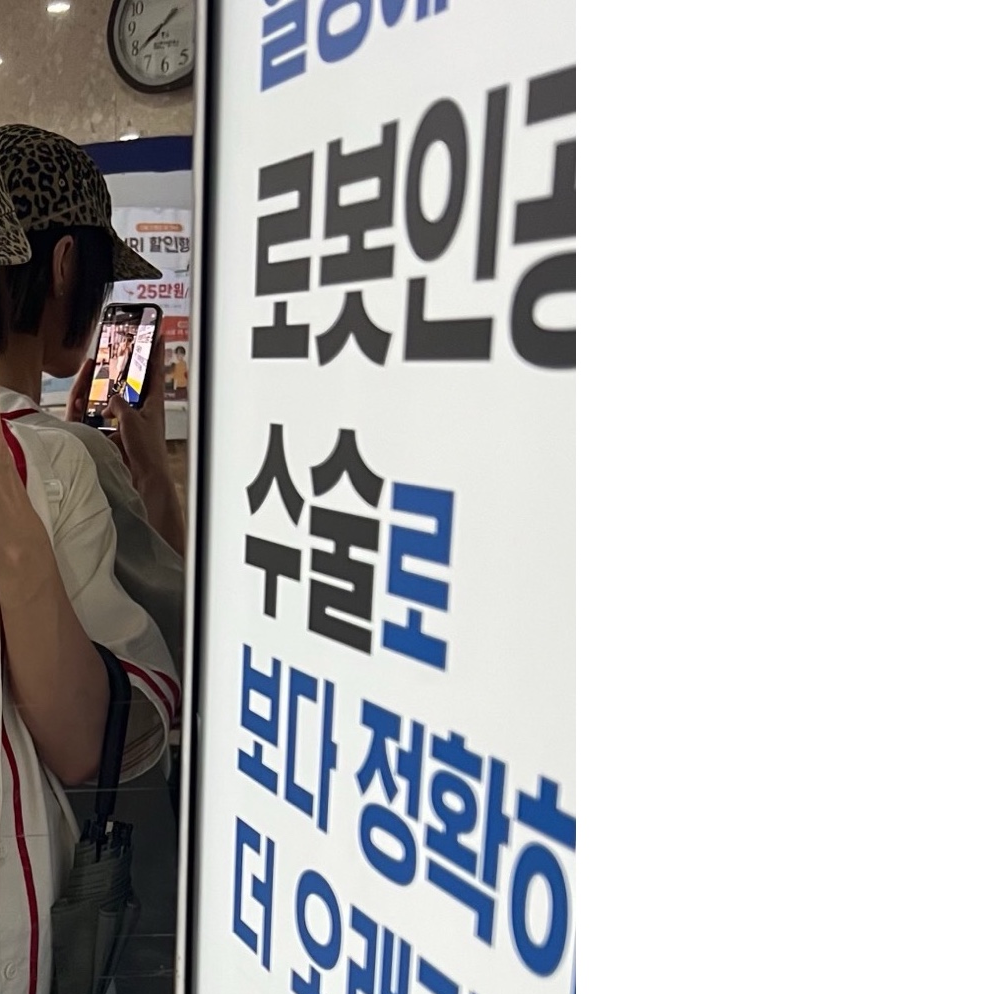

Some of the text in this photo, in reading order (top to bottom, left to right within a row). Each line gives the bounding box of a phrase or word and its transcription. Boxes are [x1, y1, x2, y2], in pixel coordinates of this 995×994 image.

[131, 1, 144, 17] 10
[128, 21, 136, 37] 9
[132, 40, 139, 56] 8
[178, 48, 189, 65] 5
[144, 54, 152, 71] 7
[161, 56, 169, 73] 6
[124, 236, 144, 253] RI
[244, 422, 455, 672] 수술로
[237, 642, 338, 834] 보다
[231, 815, 276, 973] 더
